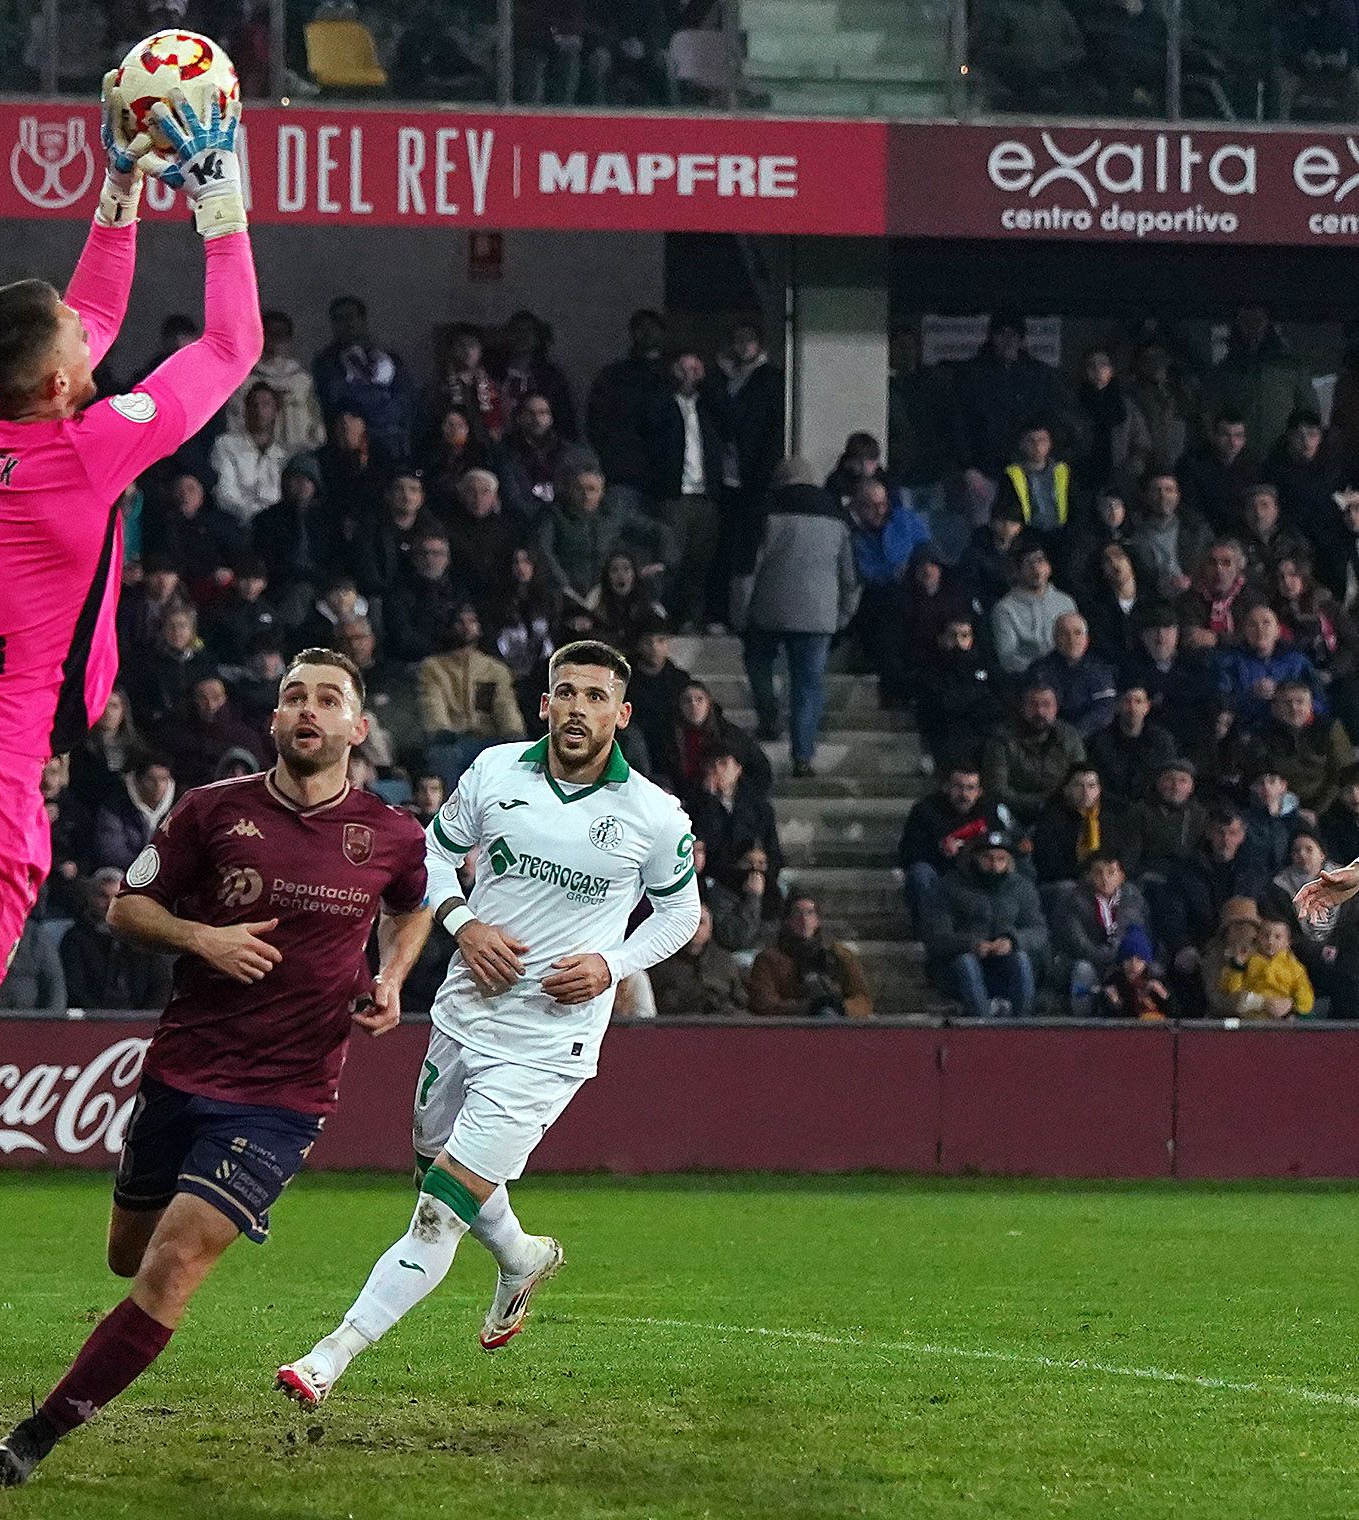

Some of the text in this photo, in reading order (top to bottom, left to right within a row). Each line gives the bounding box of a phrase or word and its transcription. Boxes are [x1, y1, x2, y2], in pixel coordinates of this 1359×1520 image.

[277, 124, 374, 214] DEL
[398, 127, 494, 216] REY
[538, 151, 799, 198] MAPFRE
[987, 131, 1258, 208] exalta
[1001, 202, 1240, 238] centro deportivo
[272, 878, 371, 904] Deputación
[519, 853, 611, 898] TECNOCASA
[269, 893, 365, 918] Pontevedra
[566, 891, 606, 907] GROUP
